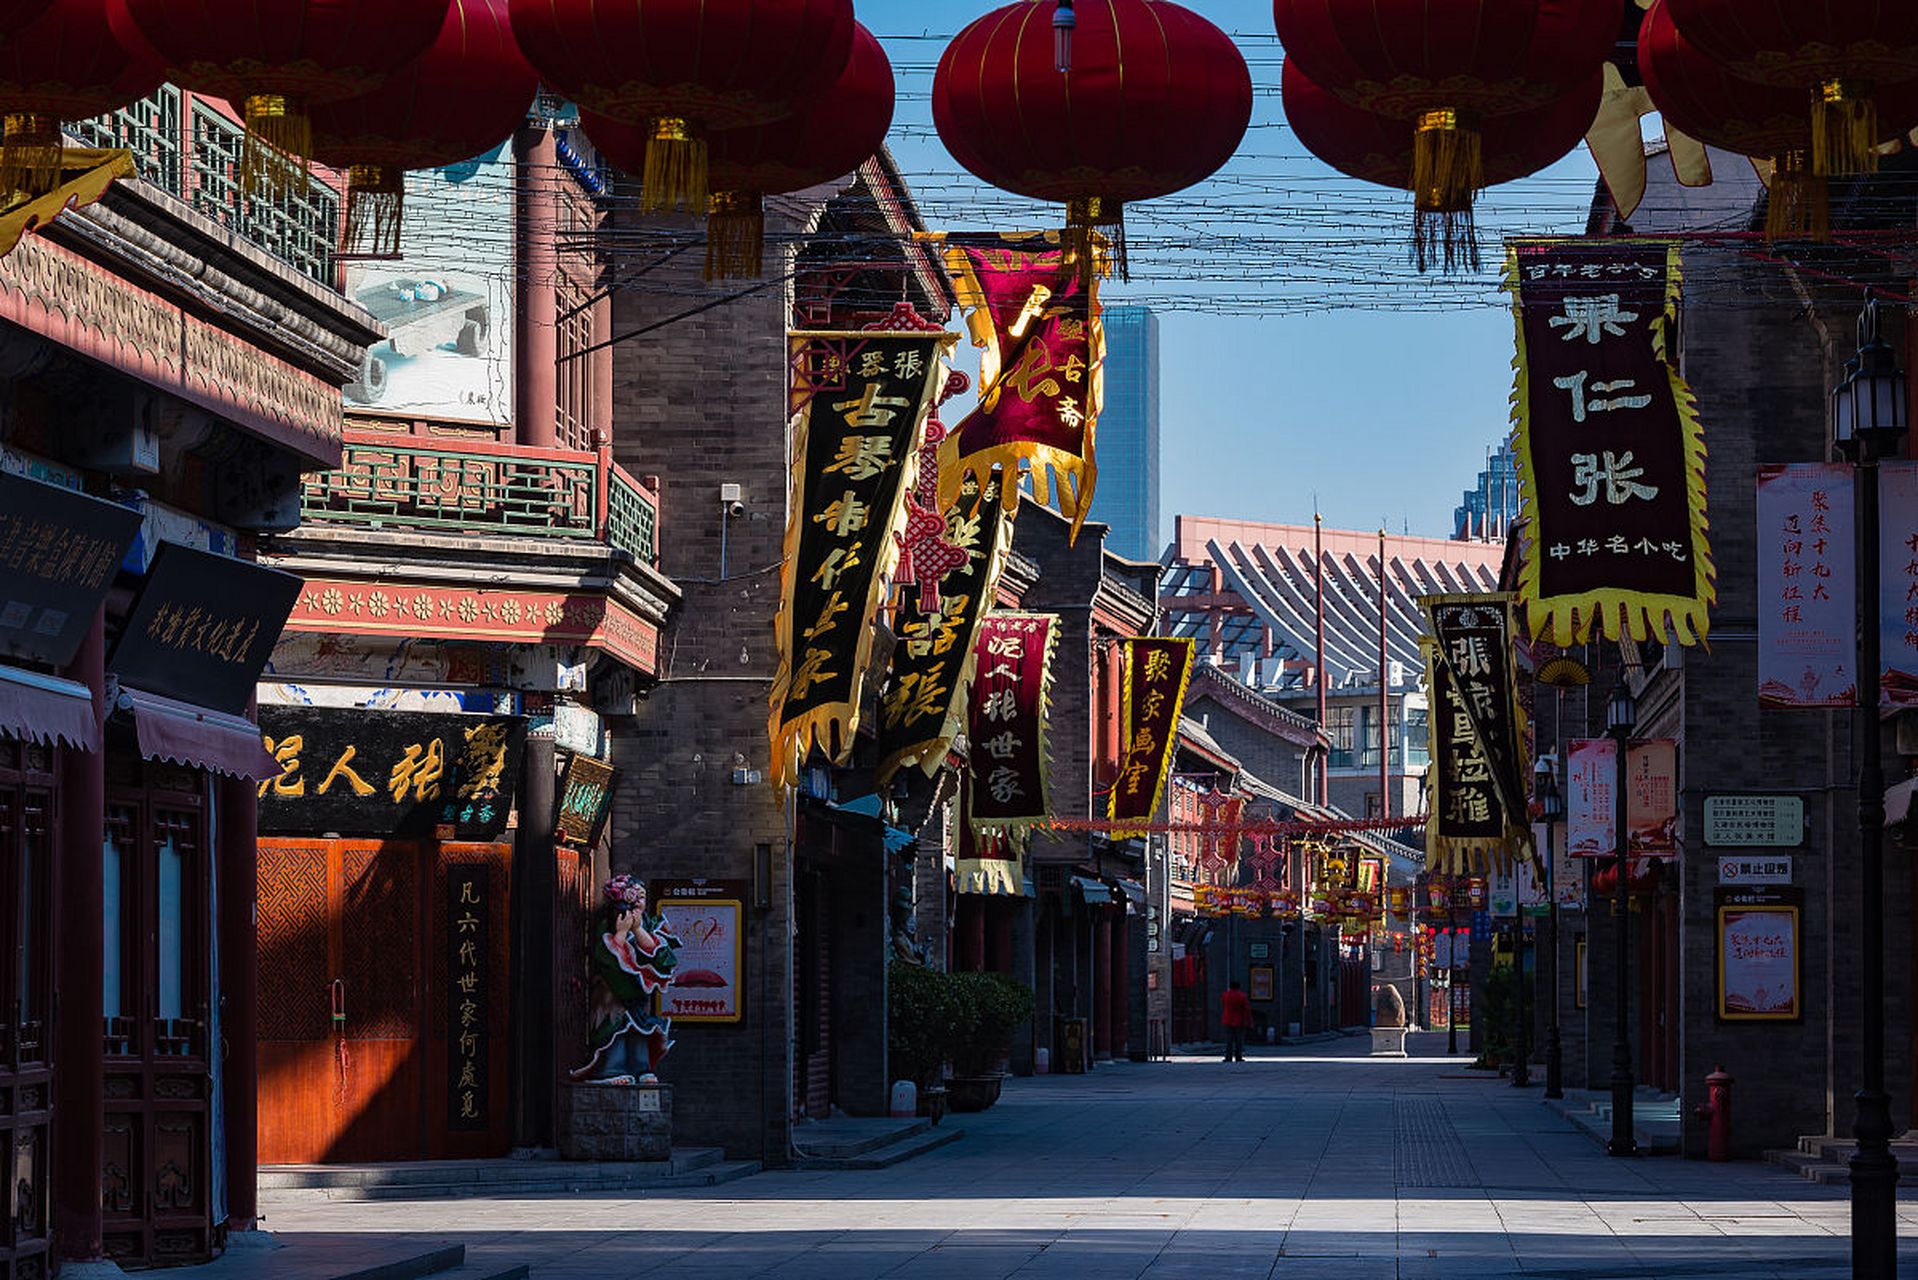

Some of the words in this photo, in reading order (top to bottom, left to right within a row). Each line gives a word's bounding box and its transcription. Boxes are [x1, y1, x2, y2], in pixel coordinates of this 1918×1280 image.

[1549, 294, 1659, 506] 果仁张
[1550, 535, 1687, 561] 中华名小吃
[1811, 490, 1831, 601] 聚焦十九大
